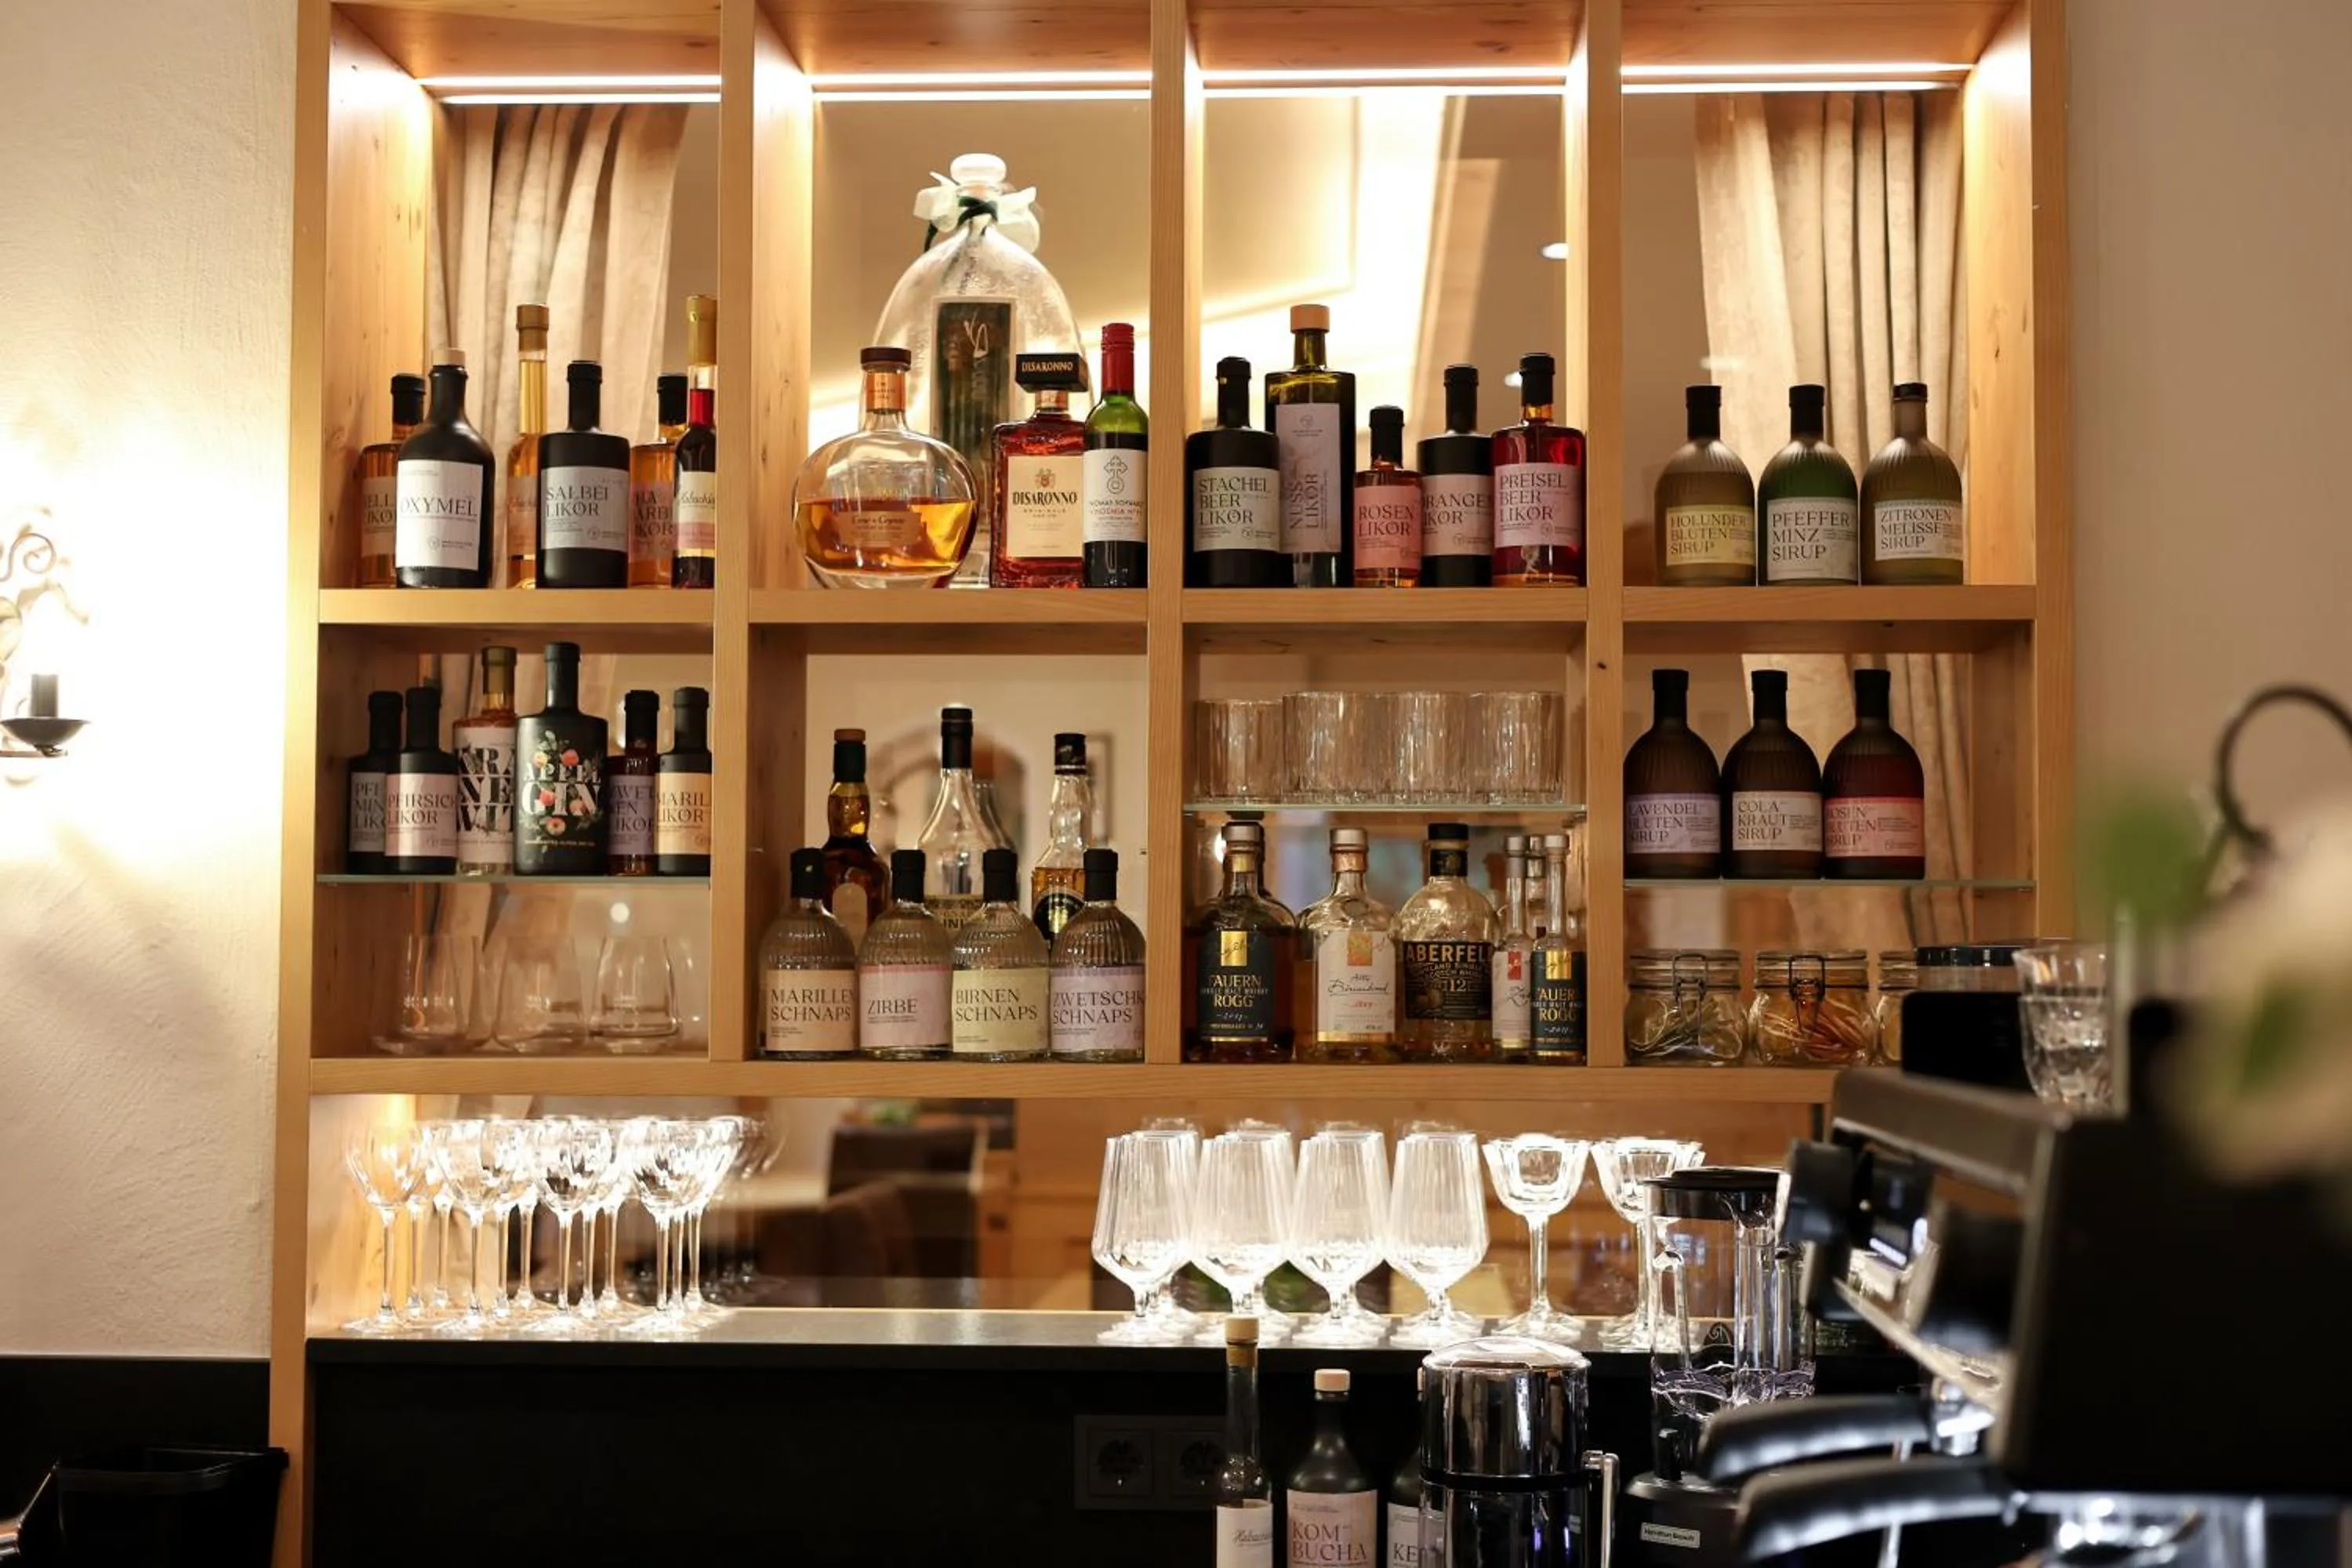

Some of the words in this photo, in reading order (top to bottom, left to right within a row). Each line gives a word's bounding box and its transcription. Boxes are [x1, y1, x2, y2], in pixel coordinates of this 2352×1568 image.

[1021, 361, 1073, 372] DISARONNO
[1199, 476, 1272, 493] STACHEL
[1500, 472, 1567, 490] PREISEL
[546, 485, 608, 501] SALBEI
[1012, 492, 1078, 506] DISARONNO
[1200, 493, 1241, 509] BEER
[1500, 489, 1542, 506] BEER
[400, 497, 477, 517] OXYMEL
[1671, 514, 1747, 528] HOLUNDER
[1773, 510, 1850, 528] PFEFFER
[1881, 508, 1952, 523] ZITRONEN
[1773, 528, 1820, 545] MINZ
[1881, 522, 1942, 536] MELISSE
[1671, 541, 1715, 555] SIRUP
[1881, 535, 1926, 550] SIRUP
[1773, 544, 1827, 561] SIRUP
[521, 782, 601, 815] GIN
[1738, 800, 1780, 813] COLA
[1738, 814, 1788, 826] KRAUT
[1738, 827, 1783, 840] SIRUP
[1209, 975, 1263, 987] TAUERN
[956, 988, 1021, 1004] BIRNEN
[1214, 994, 1254, 1007] ROGG
[1537, 987, 1577, 1001] AUER
[771, 1006, 851, 1023] SCHNAPS
[867, 998, 918, 1015] ZIRBE
[956, 1004, 1038, 1022] SCHNAPS
[1053, 1008, 1133, 1025] SCHNAPS
[1293, 1521, 1340, 1542] KOM
[1293, 1540, 1369, 1562] BUCHA
[1394, 1542, 1417, 1563] KE
